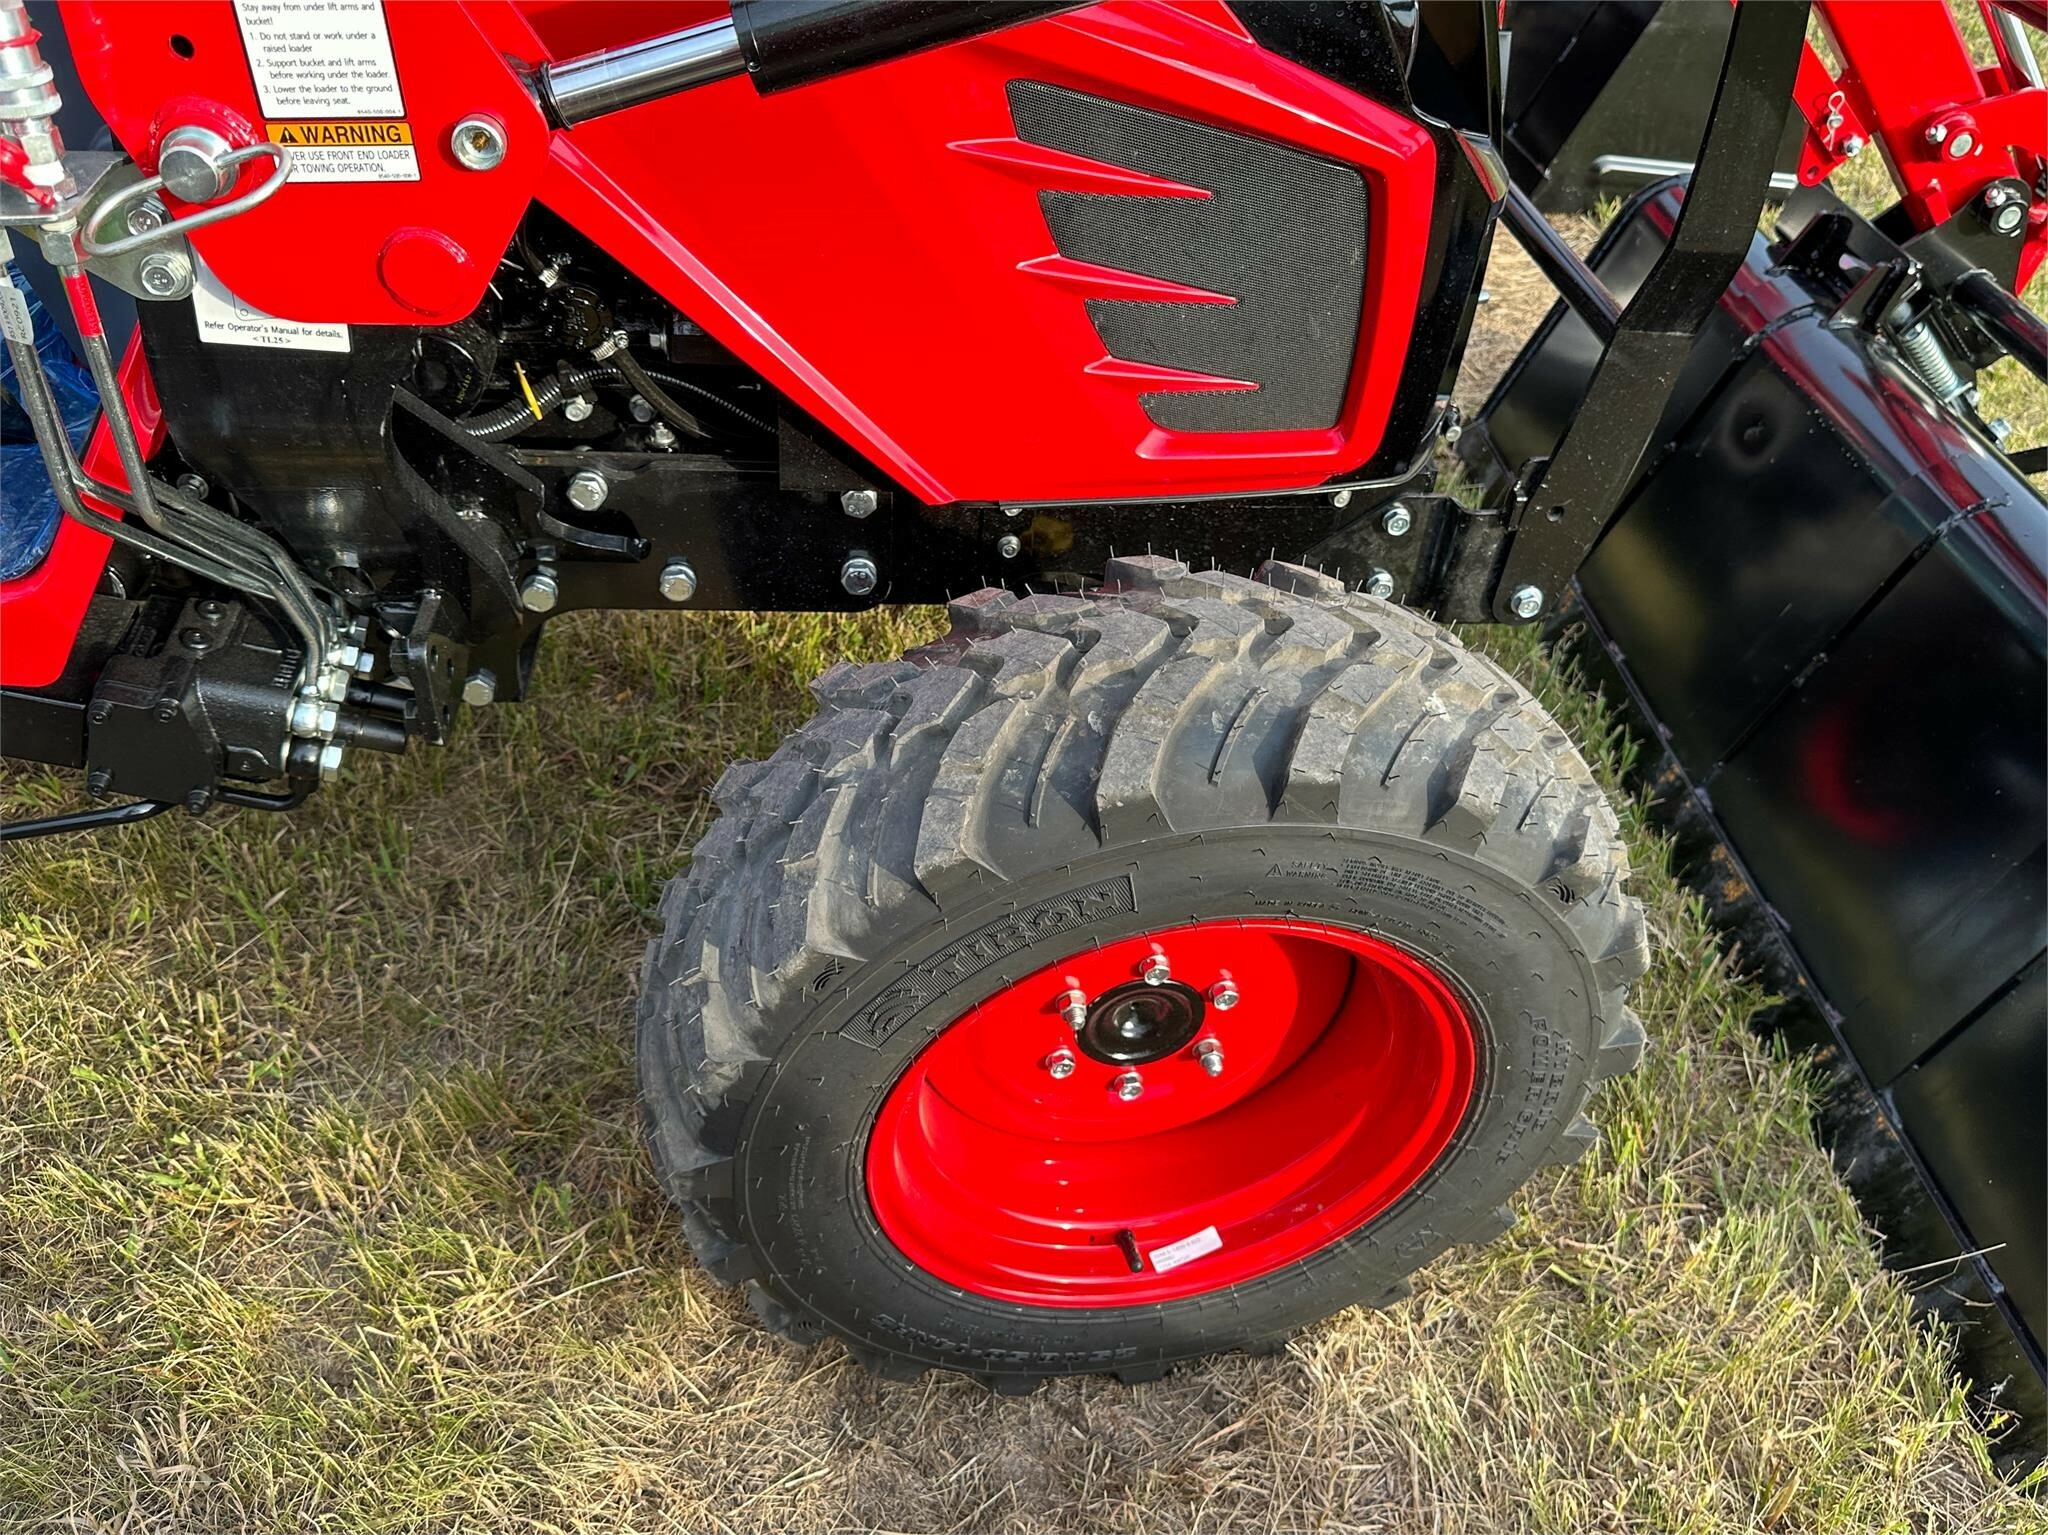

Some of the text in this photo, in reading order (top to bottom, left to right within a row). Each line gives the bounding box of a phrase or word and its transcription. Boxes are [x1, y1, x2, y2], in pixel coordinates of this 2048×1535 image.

[242, 2, 258, 13] Stay
[262, 4, 280, 13] away
[283, 2, 301, 11] from
[304, 2, 324, 11] under
[328, 2, 338, 11] lift
[361, 2, 375, 11] and
[246, 17, 274, 25] bucket!
[250, 32, 257, 40] 1.
[260, 32, 271, 40] Do
[290, 32, 310, 40] stand
[324, 32, 343, 40] work
[346, 32, 368, 40] under
[263, 44, 312, 53] raised loader
[266, 59, 297, 68] Support
[300, 59, 325, 67] bucket
[328, 59, 342, 67] and
[270, 71, 294, 79] before
[296, 71, 325, 80] working
[328, 70, 348, 78] under
[351, 70, 363, 78] the
[264, 86, 271, 94] 3.
[273, 85, 296, 93] Lower
[299, 85, 312, 93] the
[314, 85, 337, 93] loader
[366, 85, 393, 94] ground
[276, 97, 301, 105] before
[303, 97, 330, 106] leaving
[300, 125, 402, 143] WARNING
[308, 151, 325, 160] USE
[328, 151, 354, 160] FRONT
[358, 150, 375, 160] END
[378, 150, 410, 160] LOADER
[302, 164, 335, 173] TOWING
[338, 163, 386, 173] OPERATION.
[204, 320, 343, 338] Refer Operator's Manual for details.
[1285, 870, 1328, 880] WARNING
[928, 888, 1121, 980] TIRON
